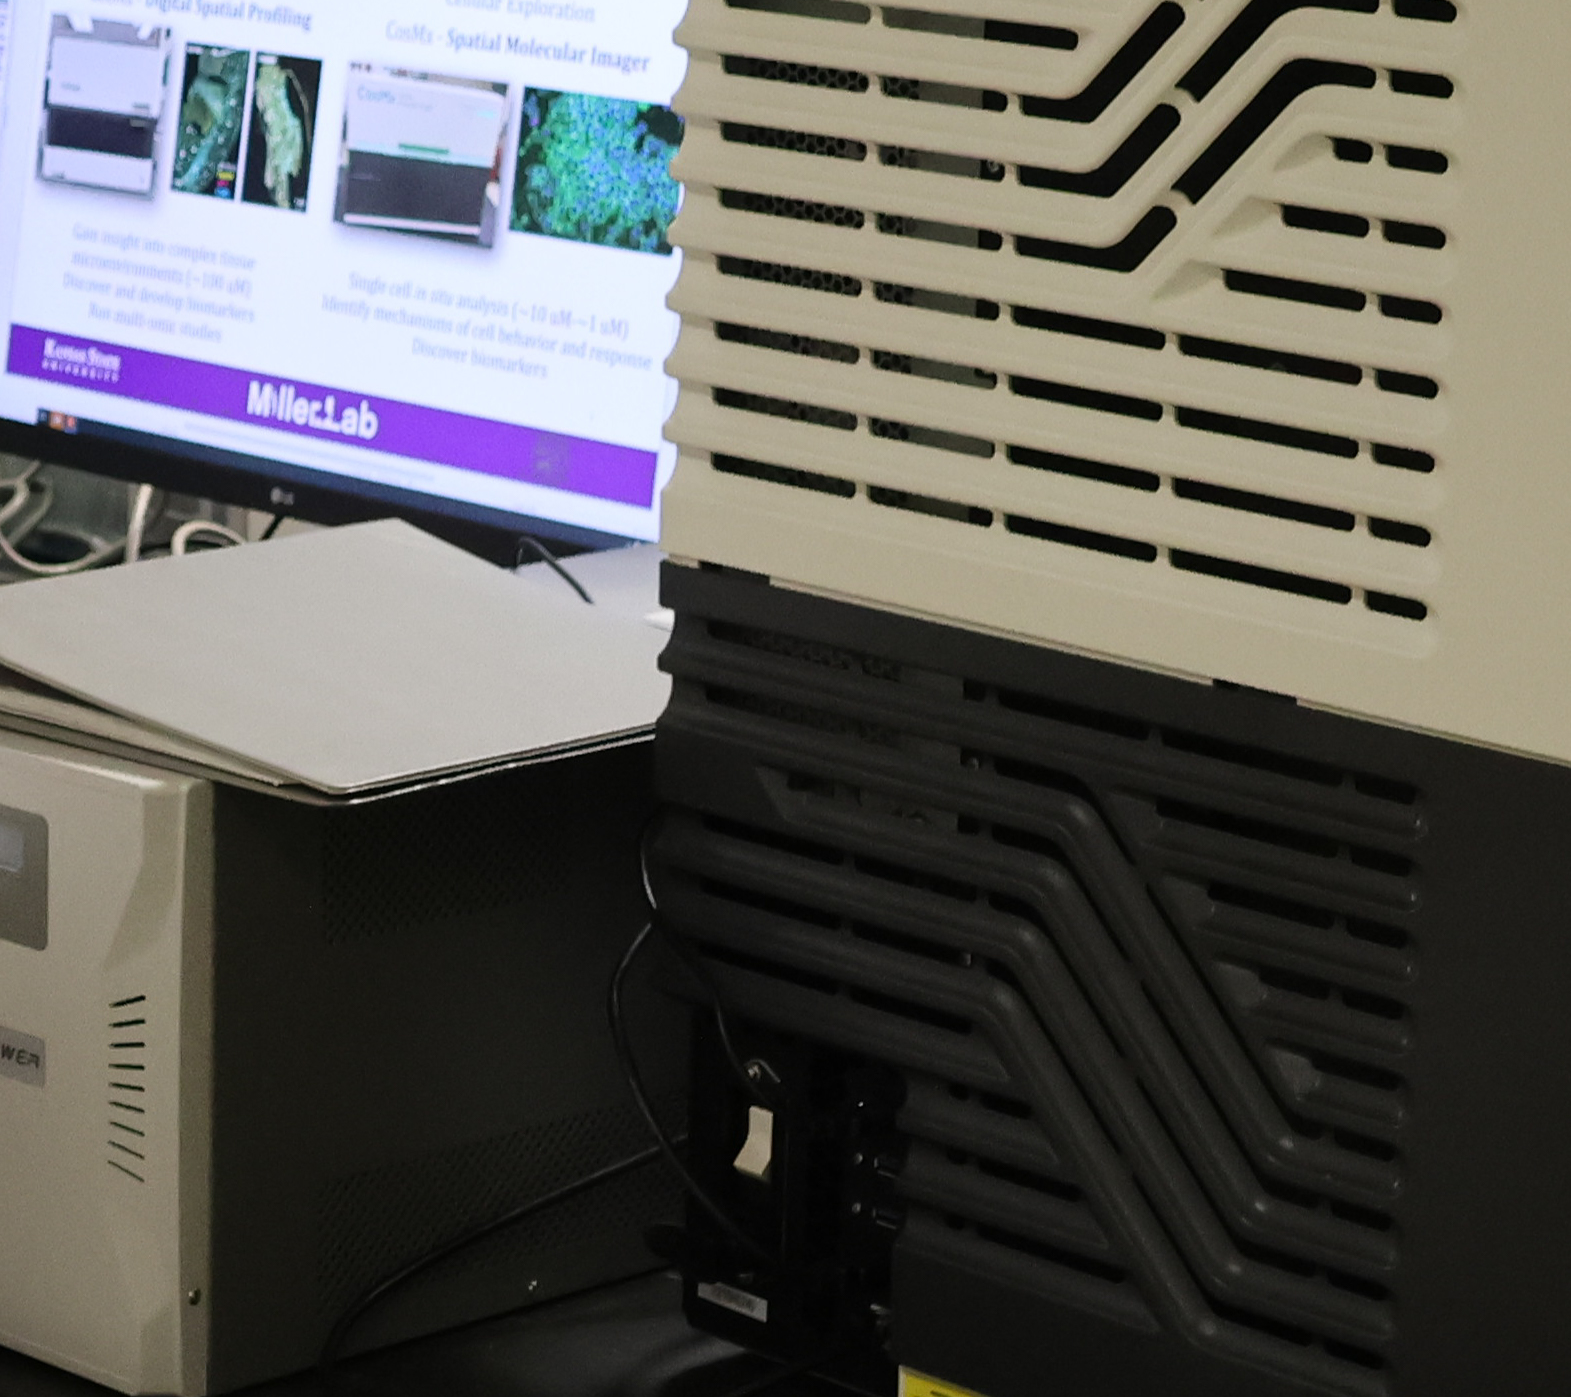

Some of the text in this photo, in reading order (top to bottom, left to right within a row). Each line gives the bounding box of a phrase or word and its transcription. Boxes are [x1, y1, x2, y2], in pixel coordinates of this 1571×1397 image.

[247, 3, 314, 31] Profiling
[385, 20, 433, 45] CosMx
[446, 28, 502, 56] Spatial
[504, 33, 587, 64] Molecular
[589, 44, 651, 76] Imager
[348, 271, 387, 297] Single
[388, 281, 413, 301] cell
[455, 293, 510, 319] analysis
[410, 337, 550, 379] Discover biomarkers
[559, 341, 588, 361] and
[588, 347, 654, 373] response
